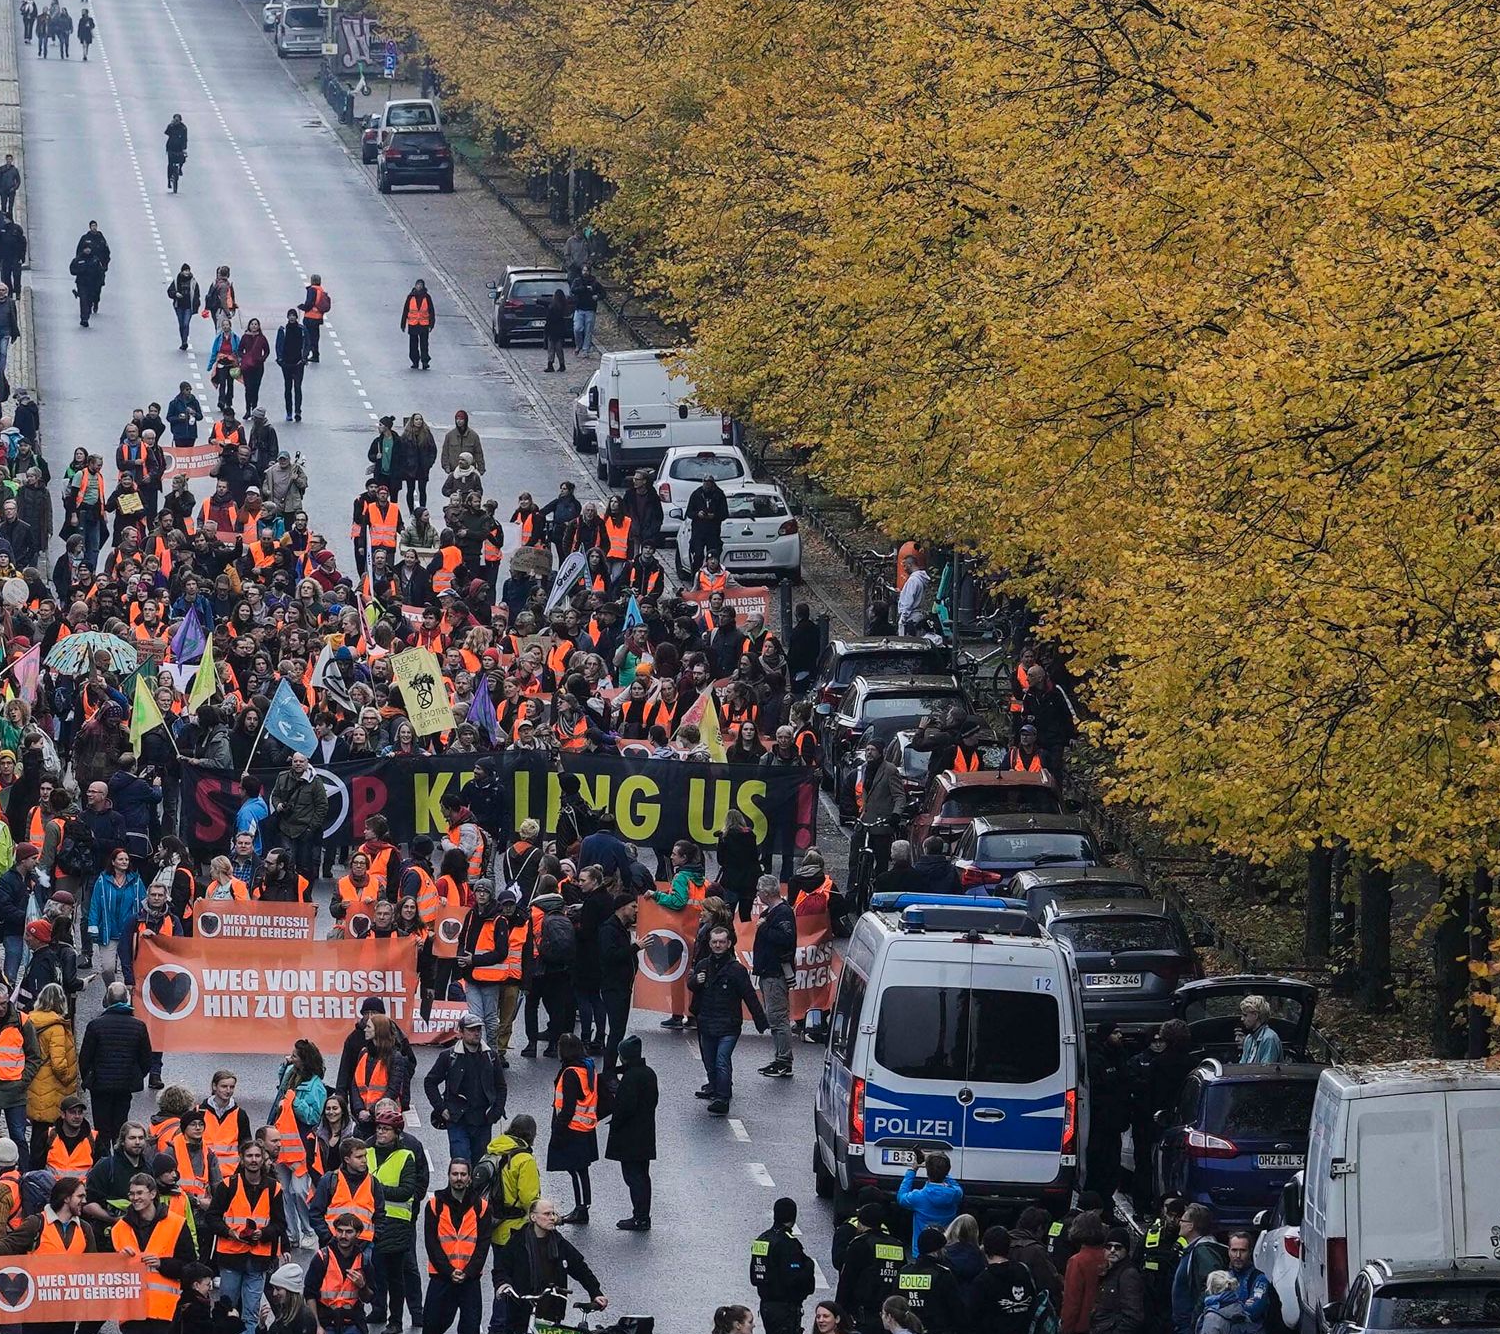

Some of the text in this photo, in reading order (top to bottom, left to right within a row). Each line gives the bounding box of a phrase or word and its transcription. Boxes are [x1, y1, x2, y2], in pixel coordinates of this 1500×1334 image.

[223, 914, 309, 928] WEG VON FOSSIL
[223, 926, 309, 939] HIN ZU GERECHT
[201, 969, 407, 993] WEG VON FOSSIL
[1109, 975, 1123, 986] SZ
[1124, 975, 1140, 986] 346
[203, 994, 285, 1018] HIN ZU
[874, 1117, 953, 1137] POLIZEI
[1258, 1154, 1296, 1166] OHZ AL
[37, 1273, 141, 1287] WEG VON FOSSIL
[900, 1275, 931, 1288] POLIZEI
[38, 1287, 141, 1301] HIN ZU GERECHT
[908, 1291, 919, 1299] BE
